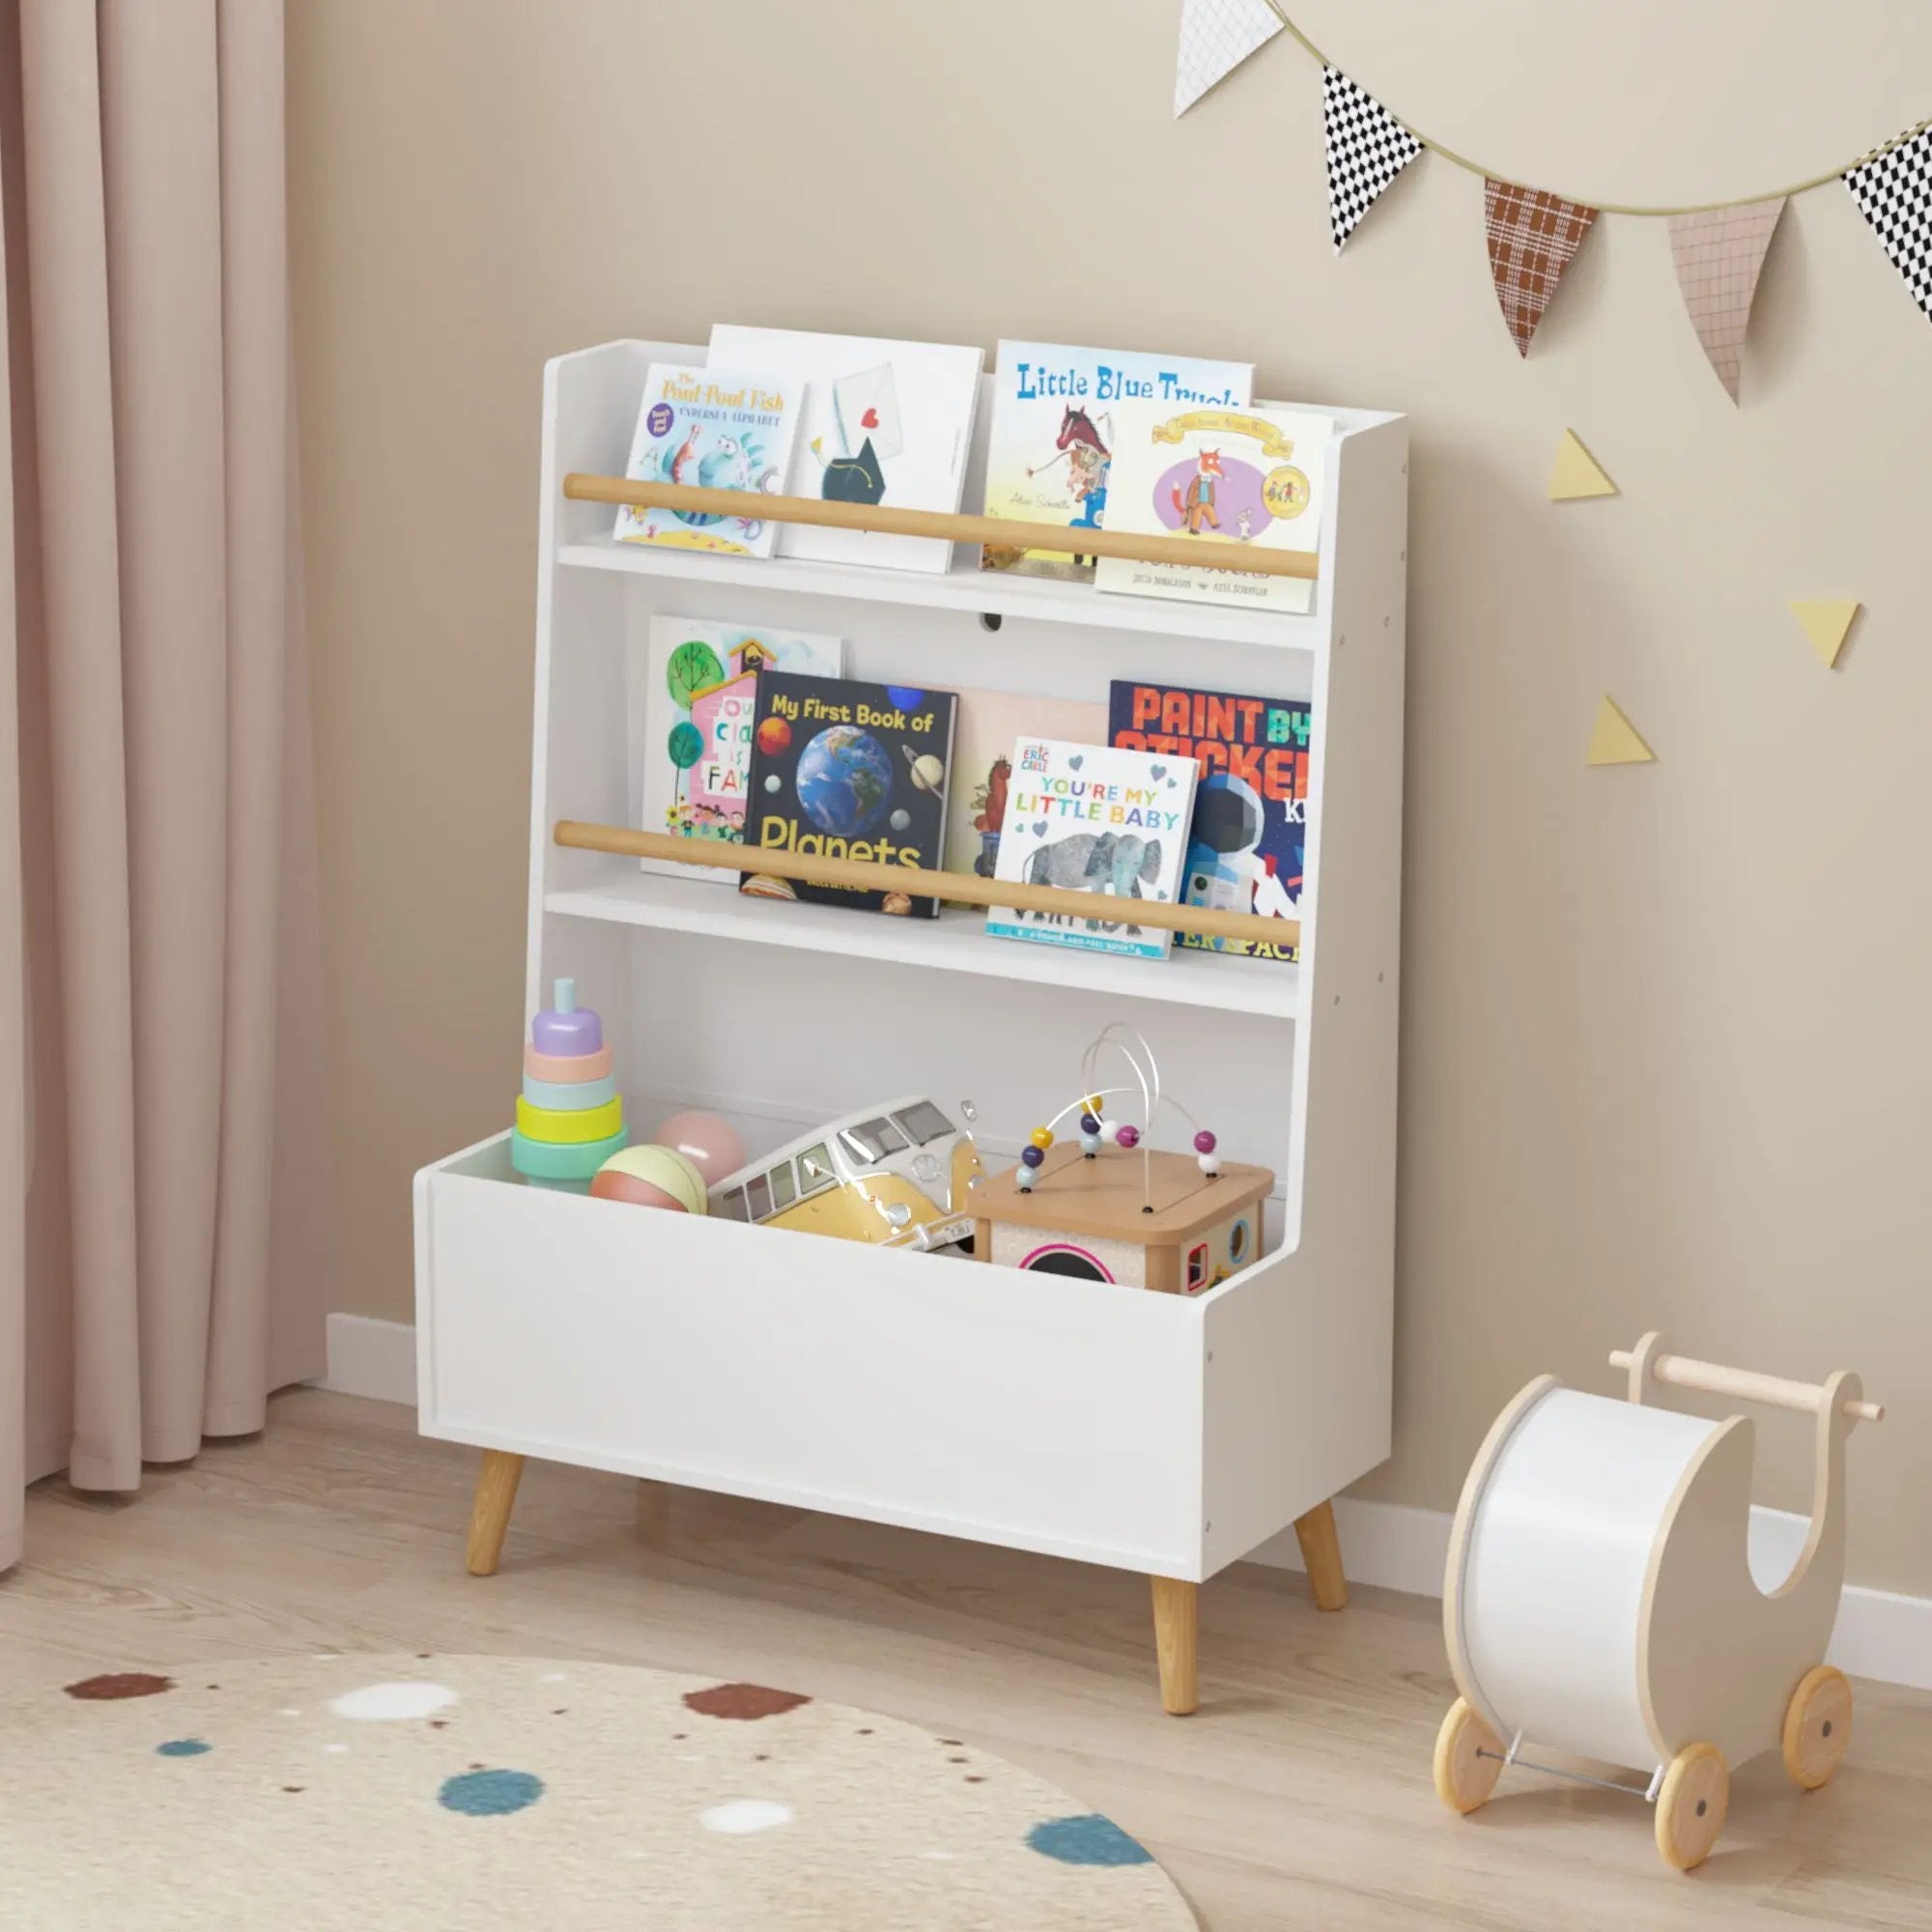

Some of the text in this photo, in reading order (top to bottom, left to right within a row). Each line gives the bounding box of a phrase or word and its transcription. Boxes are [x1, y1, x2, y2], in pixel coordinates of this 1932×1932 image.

[749, 388, 784, 412] Fish
[1016, 363, 1089, 399] Little
[1096, 364, 1153, 401] Blue
[772, 695, 935, 733] My First Book of
[1132, 686, 1264, 744] PAINT
[1041, 777, 1159, 807] YOU'RE MY
[1015, 792, 1179, 831] LITTLE BABY
[760, 815, 922, 869] Planets
